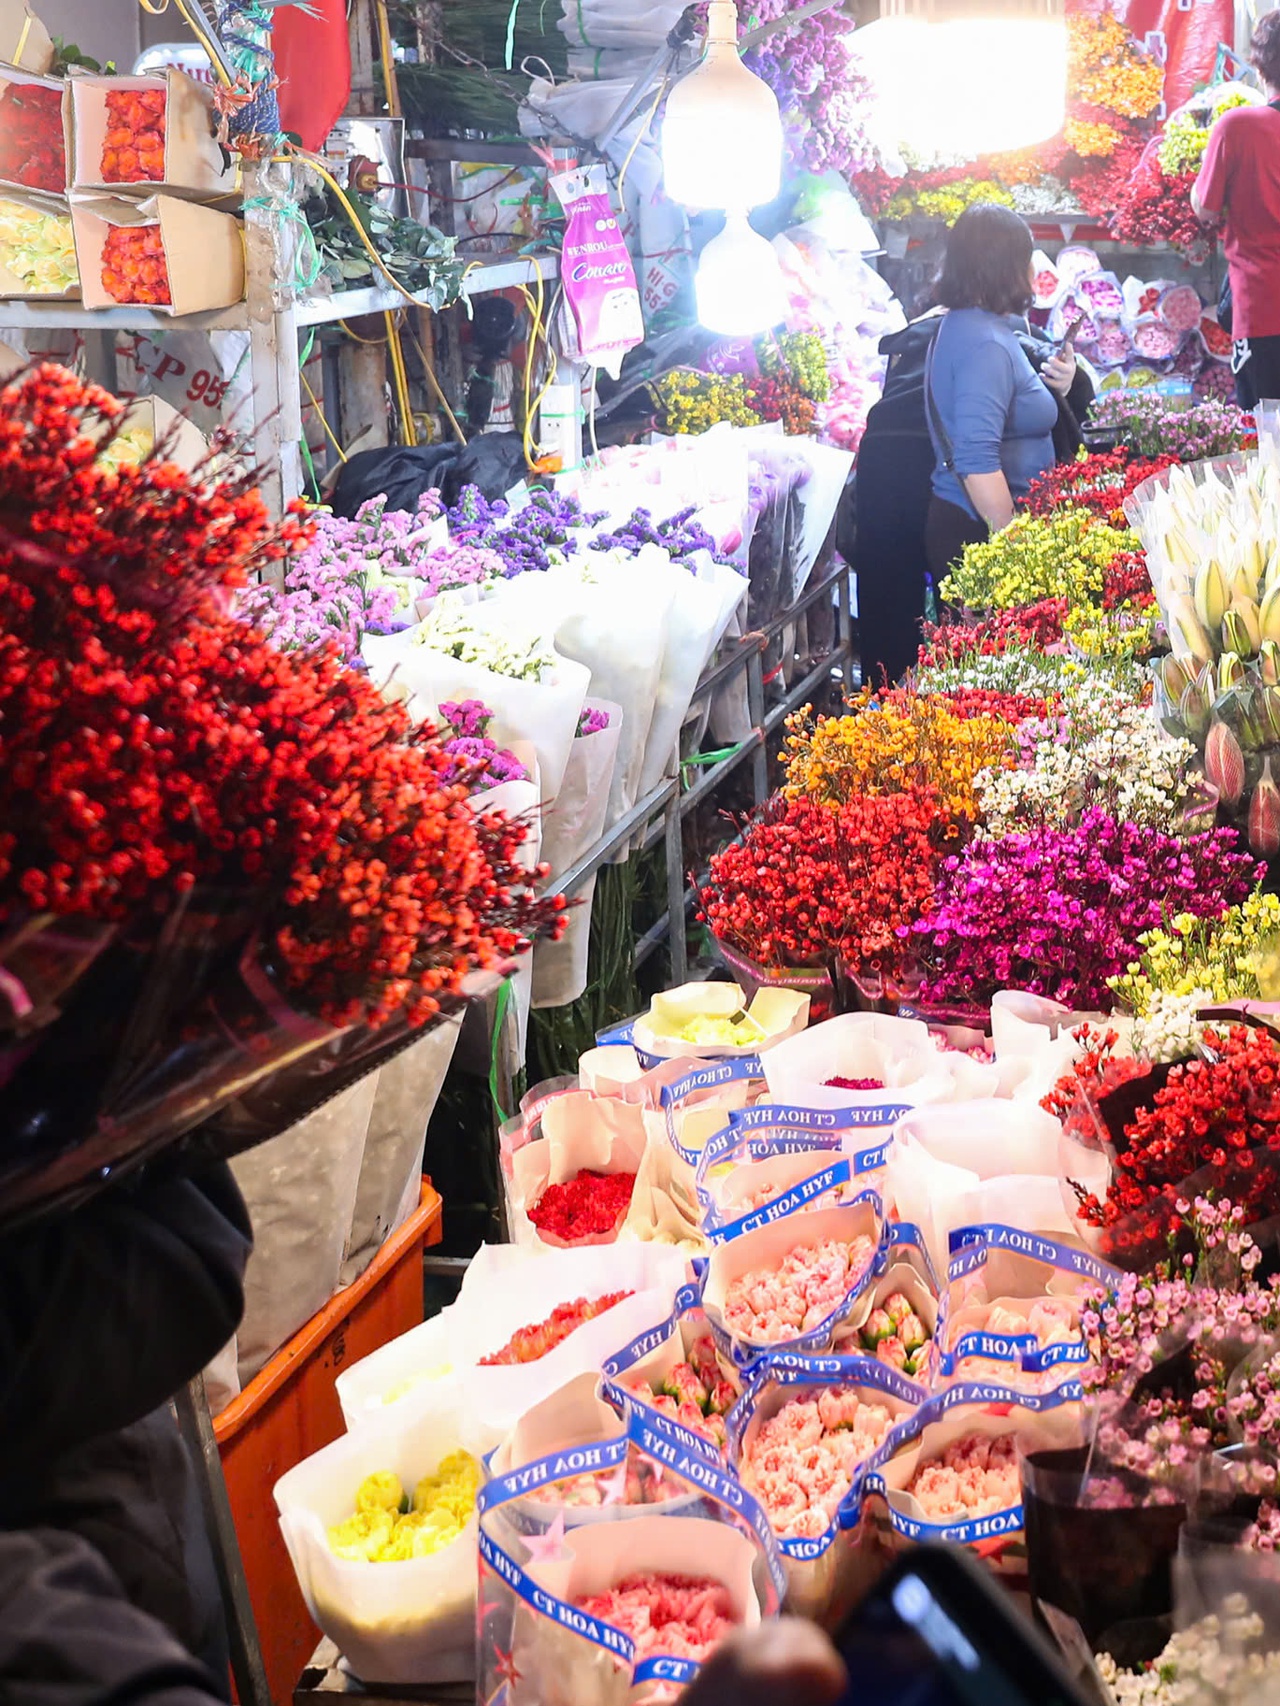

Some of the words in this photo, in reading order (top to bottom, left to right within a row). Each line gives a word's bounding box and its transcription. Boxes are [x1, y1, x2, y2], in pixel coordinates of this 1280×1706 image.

[741, 1213, 764, 1235] CT
[765, 1192, 801, 1222] HOA
[1041, 1345, 1064, 1367] CT
[940, 1525, 970, 1541] CT
[974, 1512, 1021, 1537] HOA
[532, 1590, 556, 1614] CT
[558, 1603, 600, 1640] HOA
[652, 1659, 689, 1678] CT
